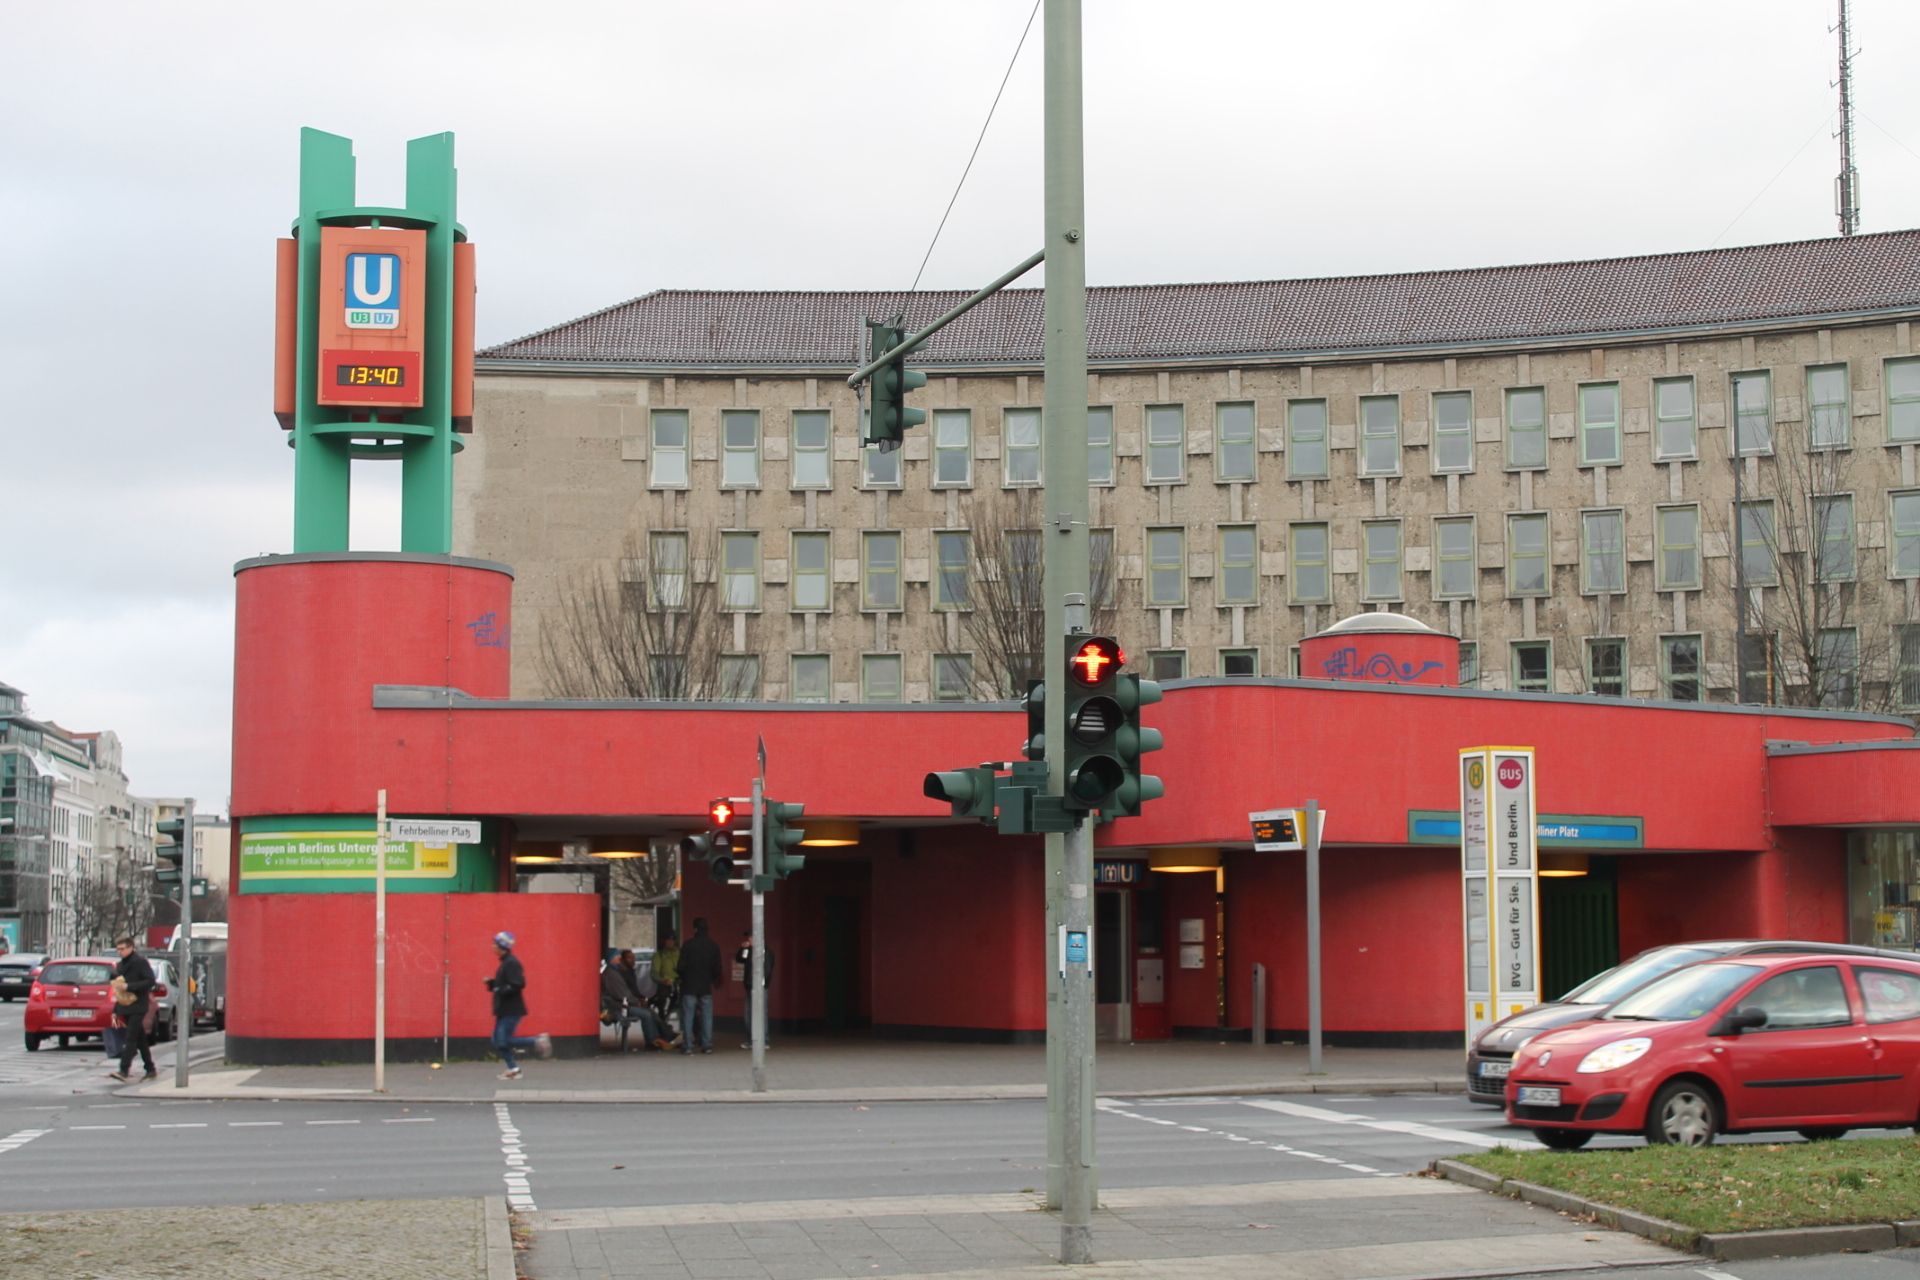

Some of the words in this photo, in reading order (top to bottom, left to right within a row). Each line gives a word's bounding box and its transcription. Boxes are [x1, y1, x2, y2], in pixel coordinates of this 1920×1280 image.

[353, 256, 393, 305] U
[353, 313, 369, 323] U3
[375, 313, 392, 324] U7
[350, 367, 399, 385] 13:40
[1500, 769, 1522, 780] BUS
[1507, 800, 1518, 838] Berlin.
[399, 825, 449, 836] Fehrbelliner
[1559, 825, 1579, 838] Platz
[287, 842, 297, 853] in
[298, 841, 336, 854] Berlins
[338, 841, 409, 856] Untergund.
[1508, 842, 1518, 866] Und
[1121, 864, 1133, 882] U
[1509, 881, 1519, 904] Sie.
[1509, 906, 1520, 924] für
[1511, 928, 1520, 950] Gut
[1511, 962, 1521, 988] BVG
